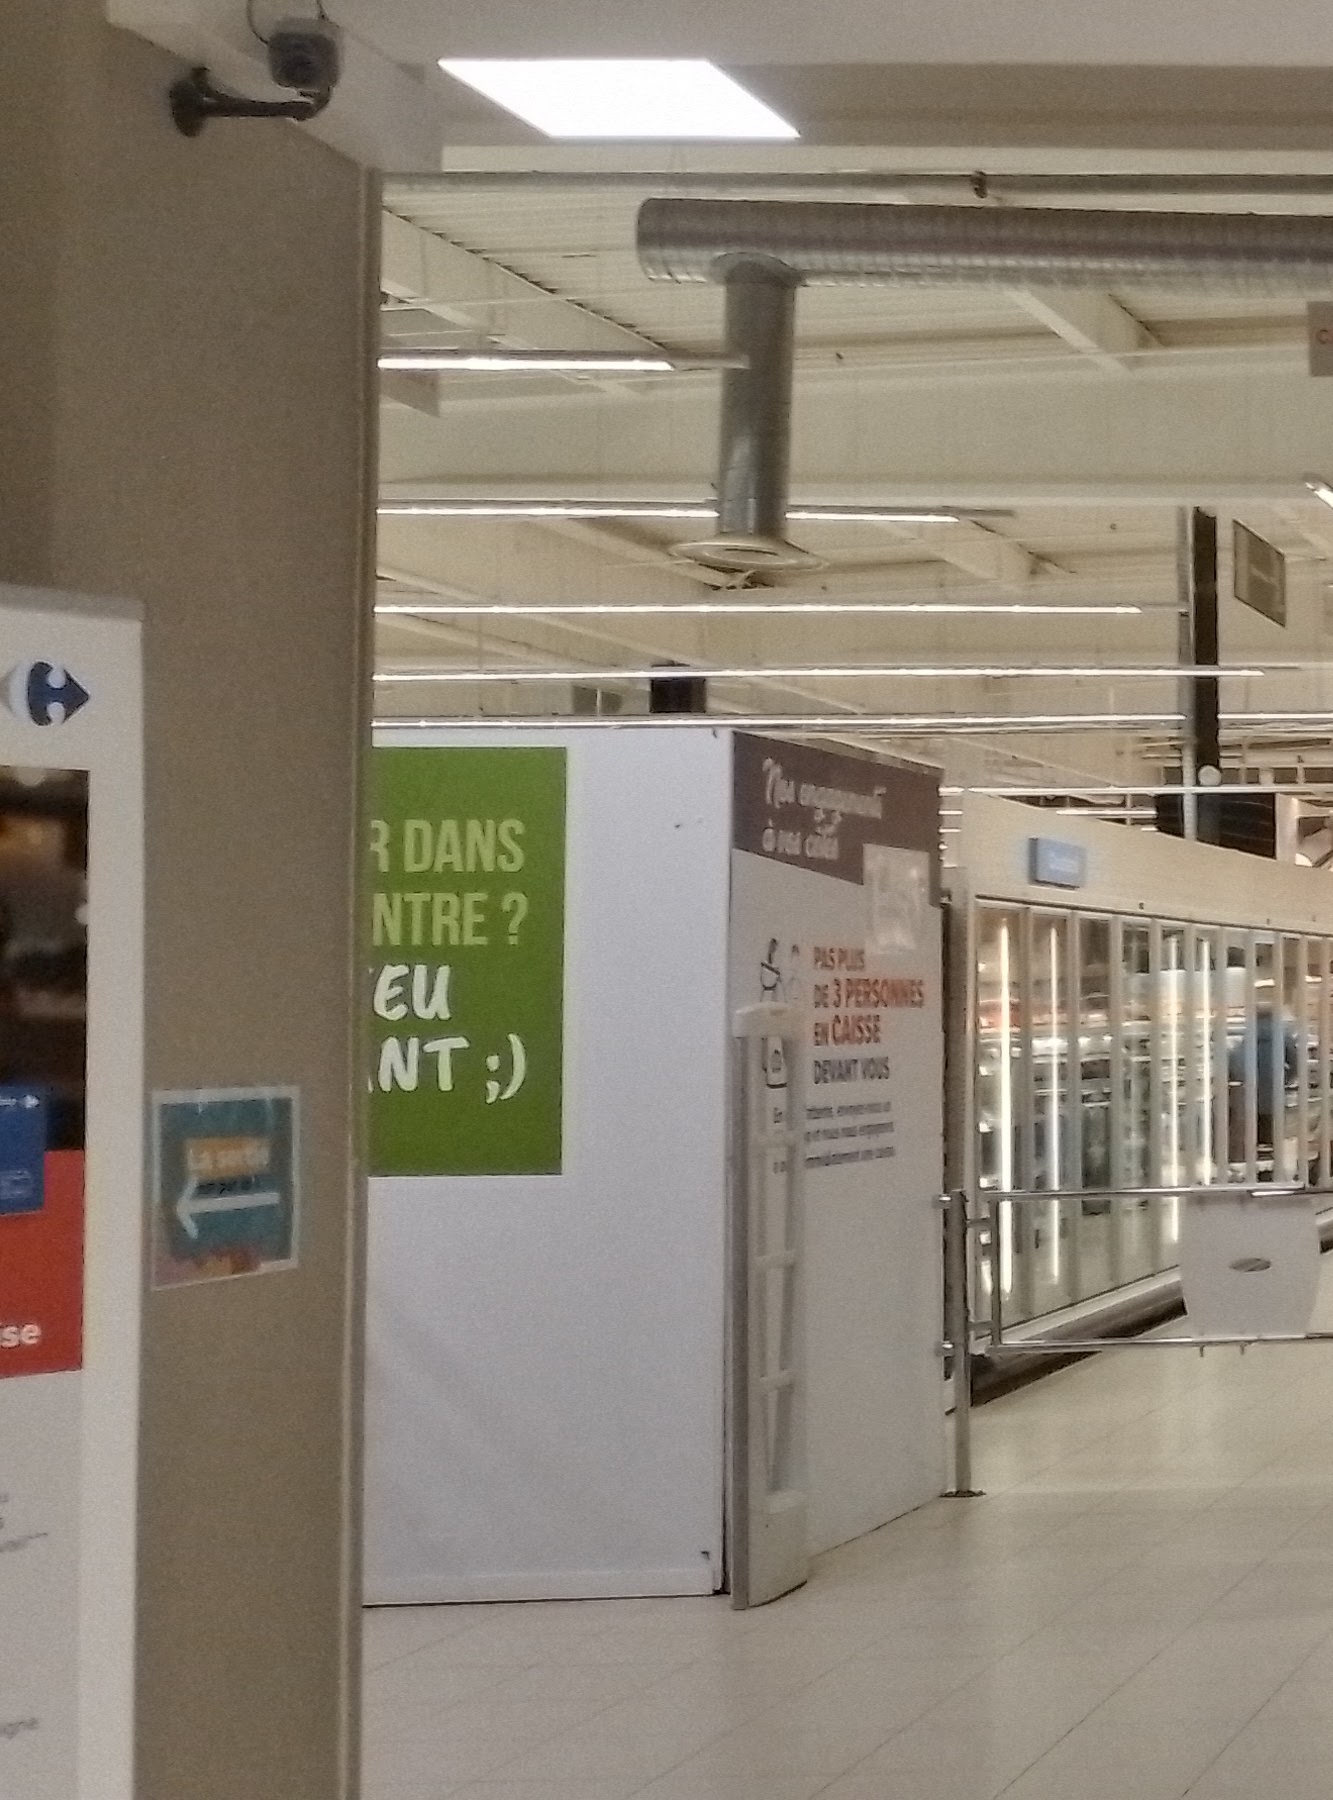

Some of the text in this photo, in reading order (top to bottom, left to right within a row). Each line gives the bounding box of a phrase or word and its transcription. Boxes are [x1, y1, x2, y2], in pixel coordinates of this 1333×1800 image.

[403, 818, 526, 873] DANS
[500, 891, 528, 946] ?
[814, 946, 865, 972] PAS PLUS
[369, 963, 452, 1021] EU
[814, 977, 925, 1009] DE 3 PERSONNES
[814, 1014, 881, 1047] EN CAISSE
[368, 1035, 470, 1093] NT
[813, 1056, 890, 1085] DEVANT VOUS
[0, 1324, 41, 1348] se
